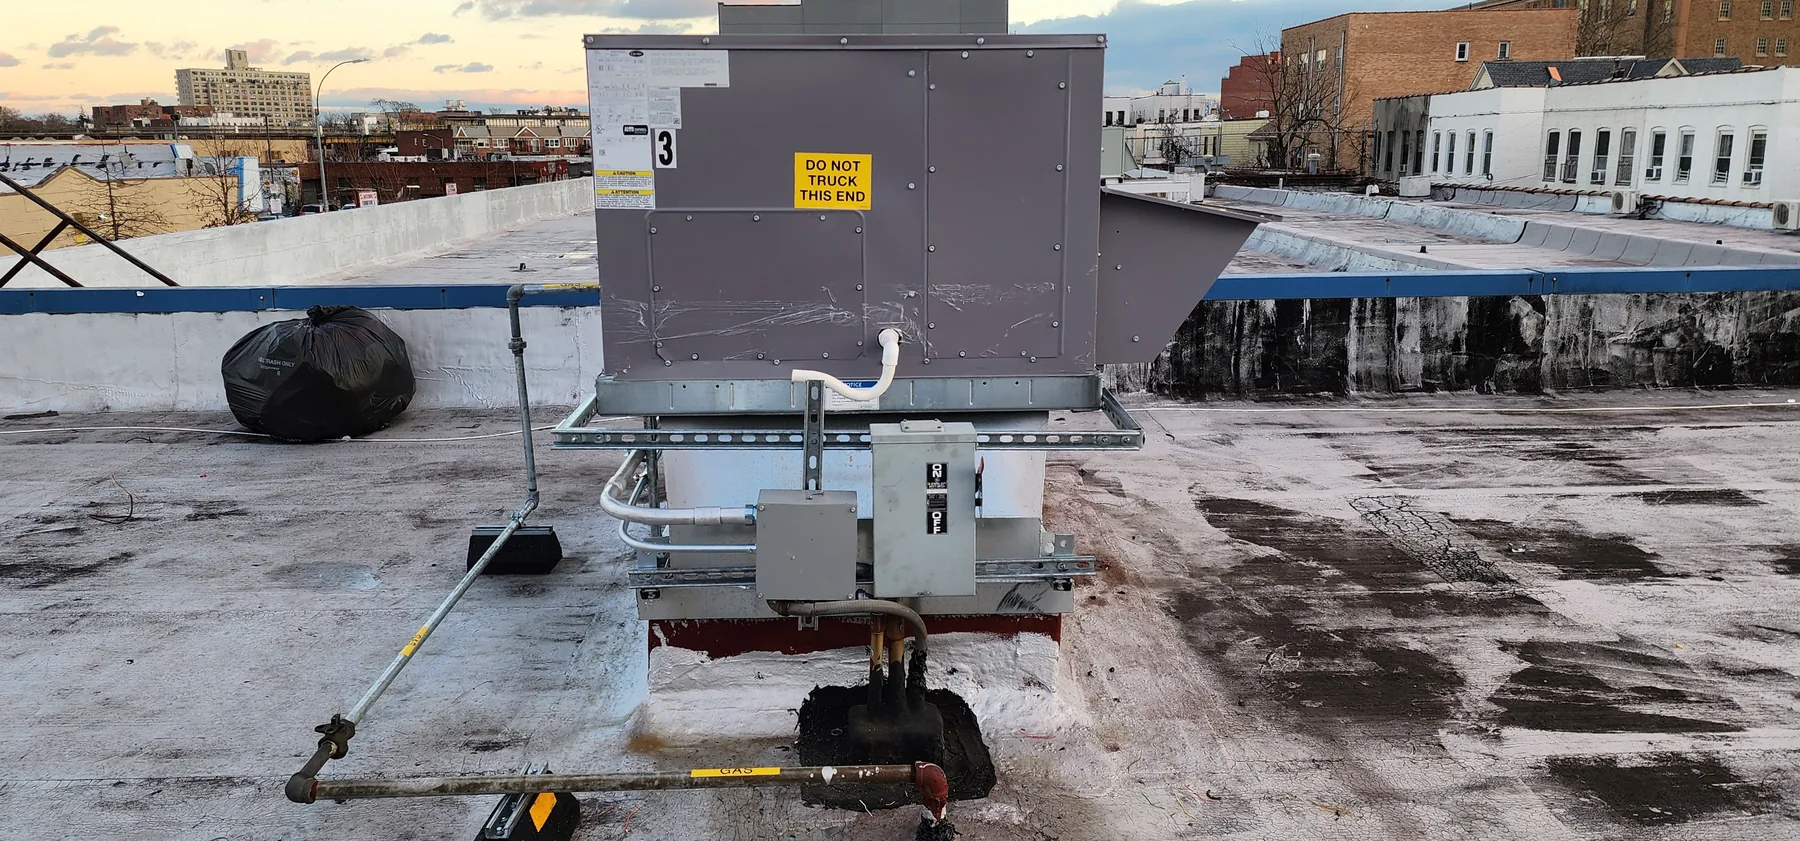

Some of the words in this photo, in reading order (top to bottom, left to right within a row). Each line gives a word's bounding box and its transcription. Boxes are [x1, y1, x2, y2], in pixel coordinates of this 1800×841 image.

[658, 131, 673, 165] 3
[806, 159, 826, 171] DO
[831, 160, 861, 171] NOT
[808, 175, 857, 186] TRUCK
[800, 190, 832, 201] THIS
[836, 190, 866, 202] END
[932, 463, 942, 478] ON
[931, 511, 942, 534] OFF
[720, 767, 753, 775] GAS
